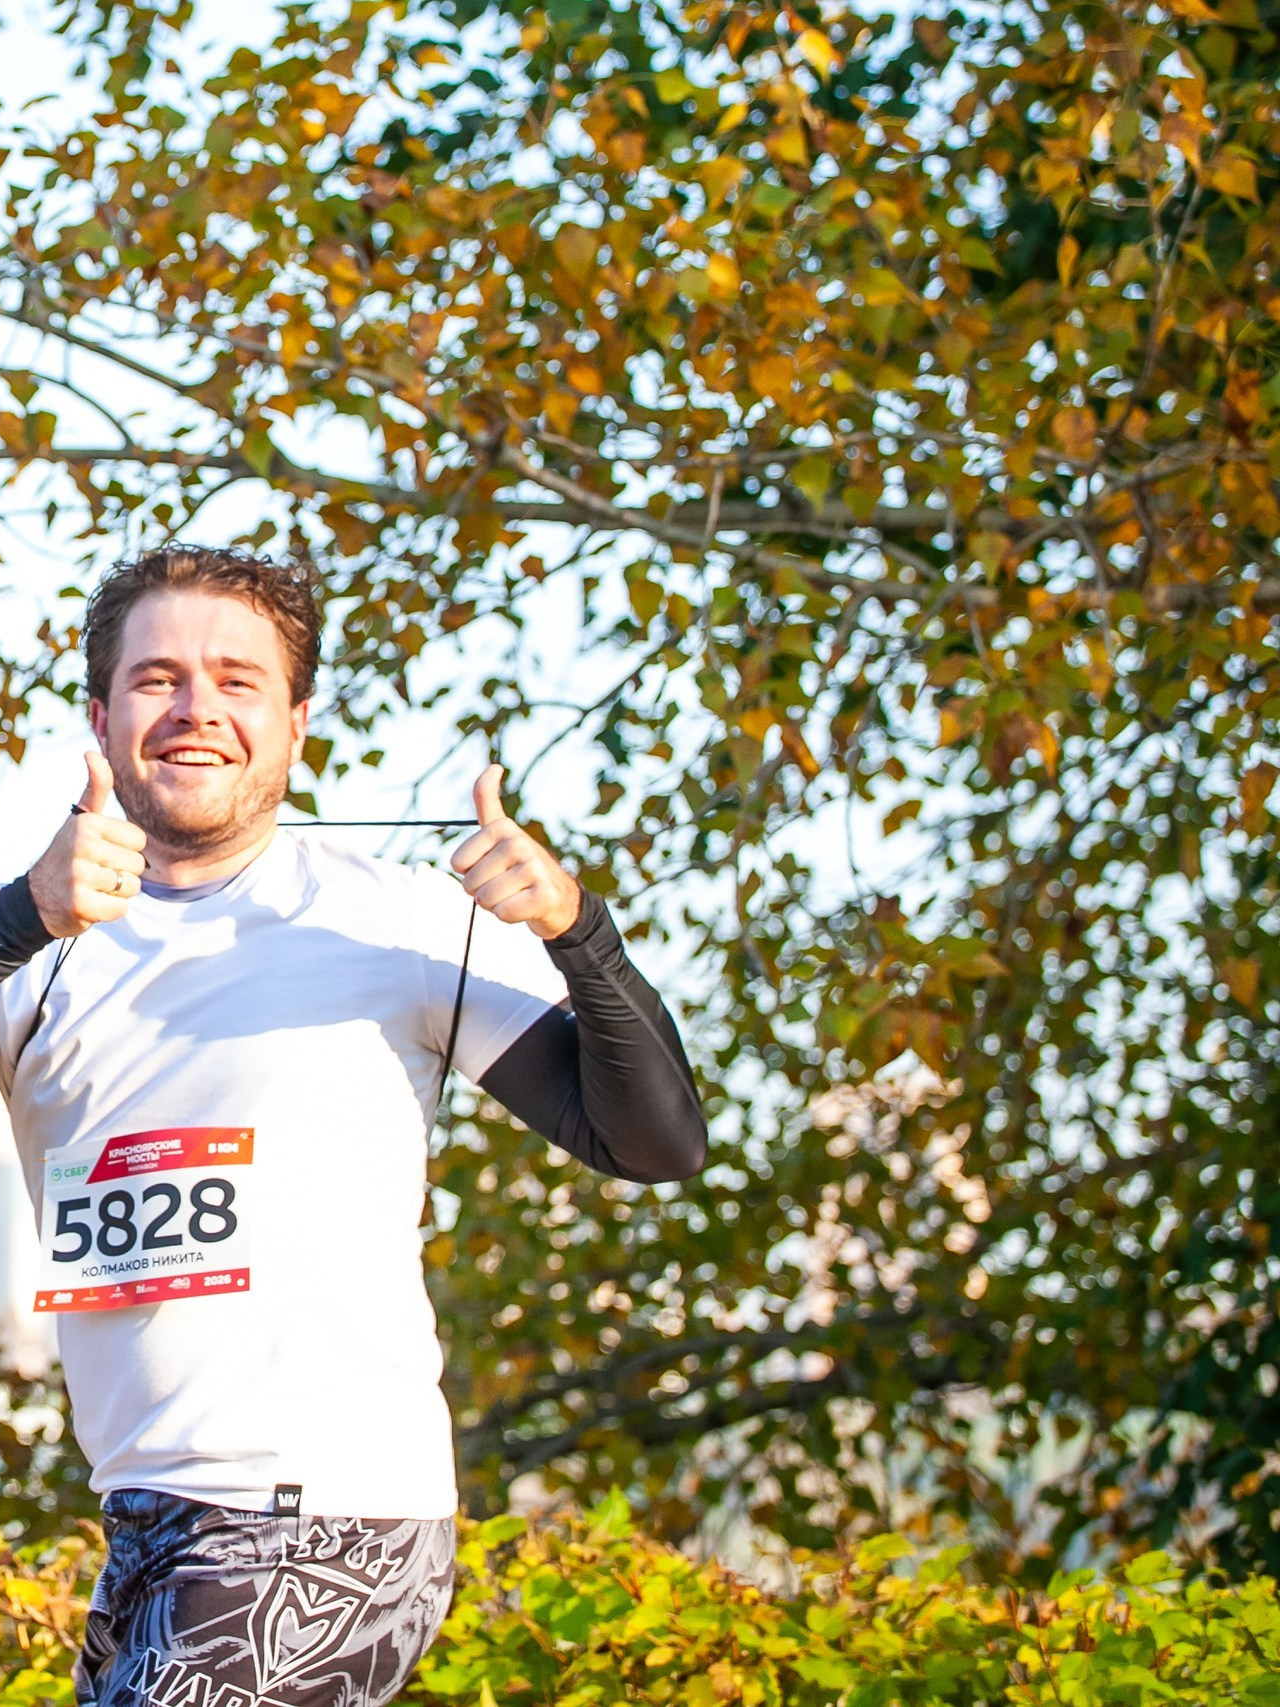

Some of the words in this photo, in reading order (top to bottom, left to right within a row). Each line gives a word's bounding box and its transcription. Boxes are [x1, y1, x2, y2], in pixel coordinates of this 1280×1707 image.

[108, 1139, 182, 1159] КРАСНОЯРСКИЕ
[207, 1142, 217, 1154] 5
[126, 1151, 161, 1165] МОСТЫ
[63, 1165, 89, 1179] СБЕР
[51, 1177, 238, 1263] 5828
[81, 1258, 150, 1278] КОЛМАКОВ
[151, 1251, 205, 1268] НИКИТА
